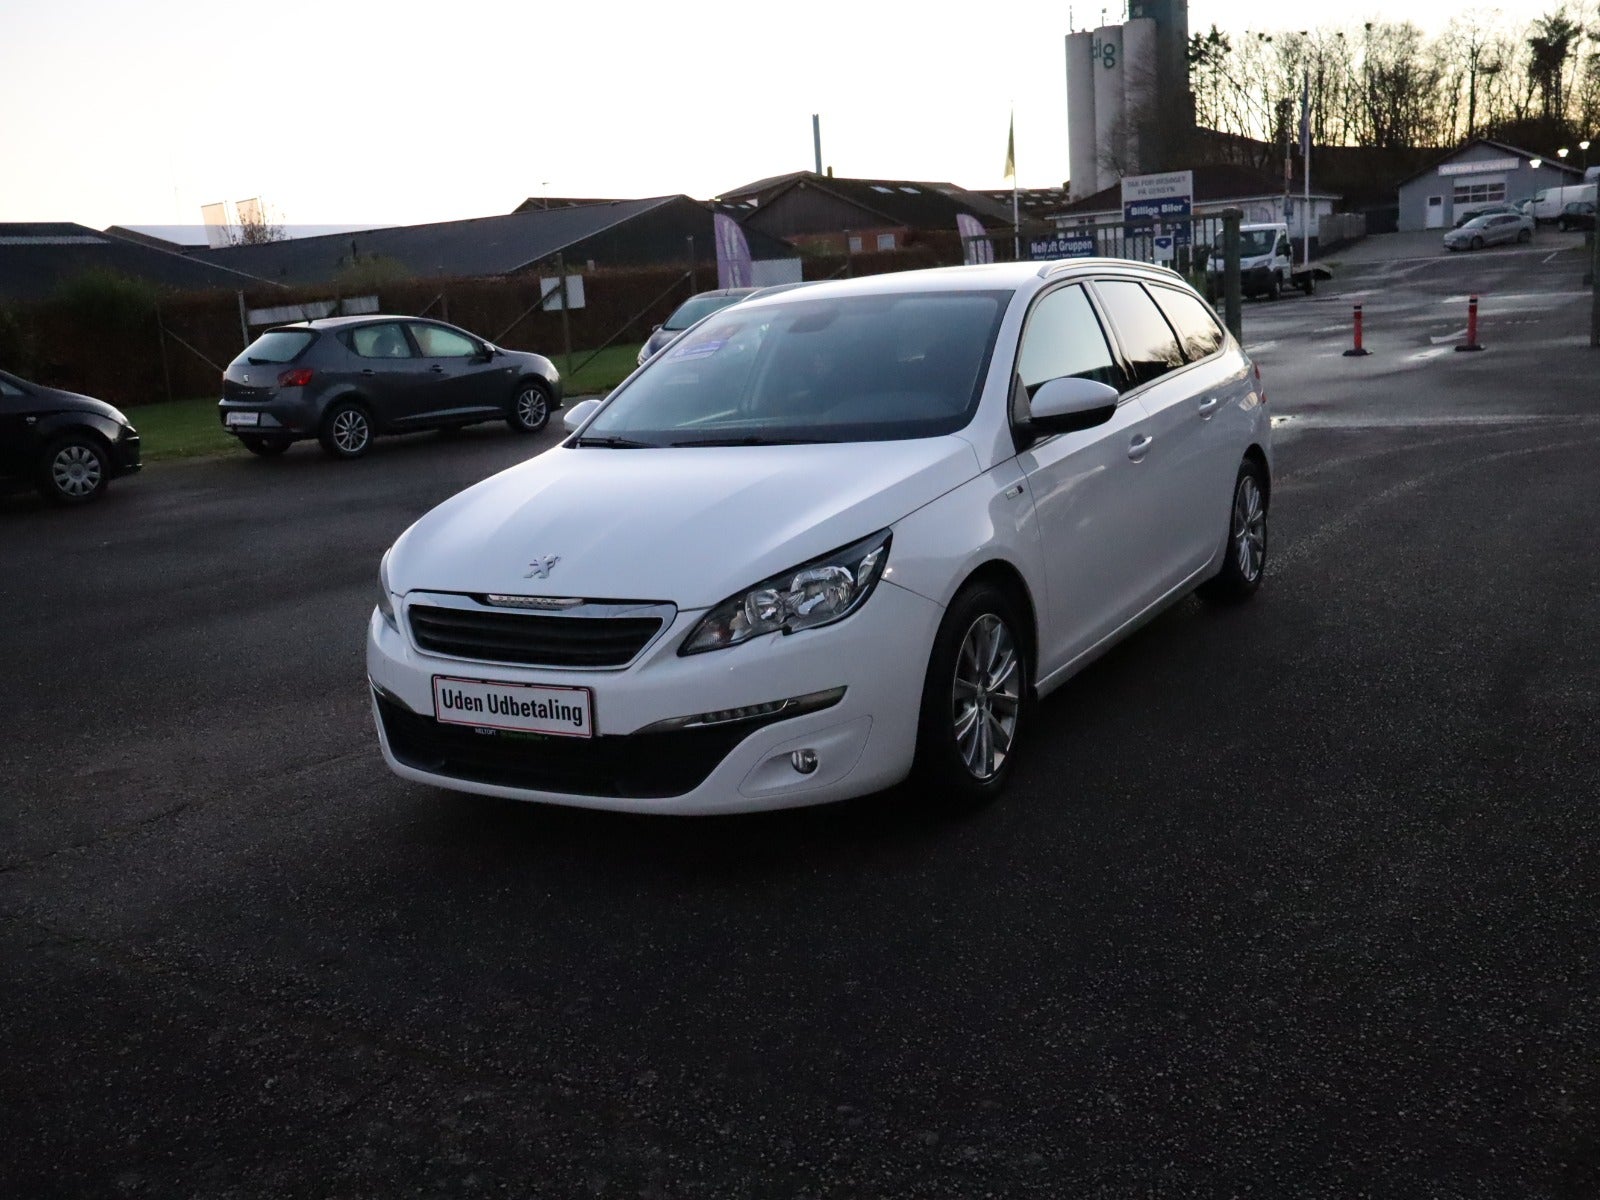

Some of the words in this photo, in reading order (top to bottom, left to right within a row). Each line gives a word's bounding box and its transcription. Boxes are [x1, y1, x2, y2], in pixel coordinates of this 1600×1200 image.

[1131, 205, 1159, 216] Billige
[1161, 203, 1183, 213] Biler
[1059, 239, 1093, 253] Gruppen
[442, 688, 483, 712] Uden
[487, 693, 583, 727] Udbetaling
